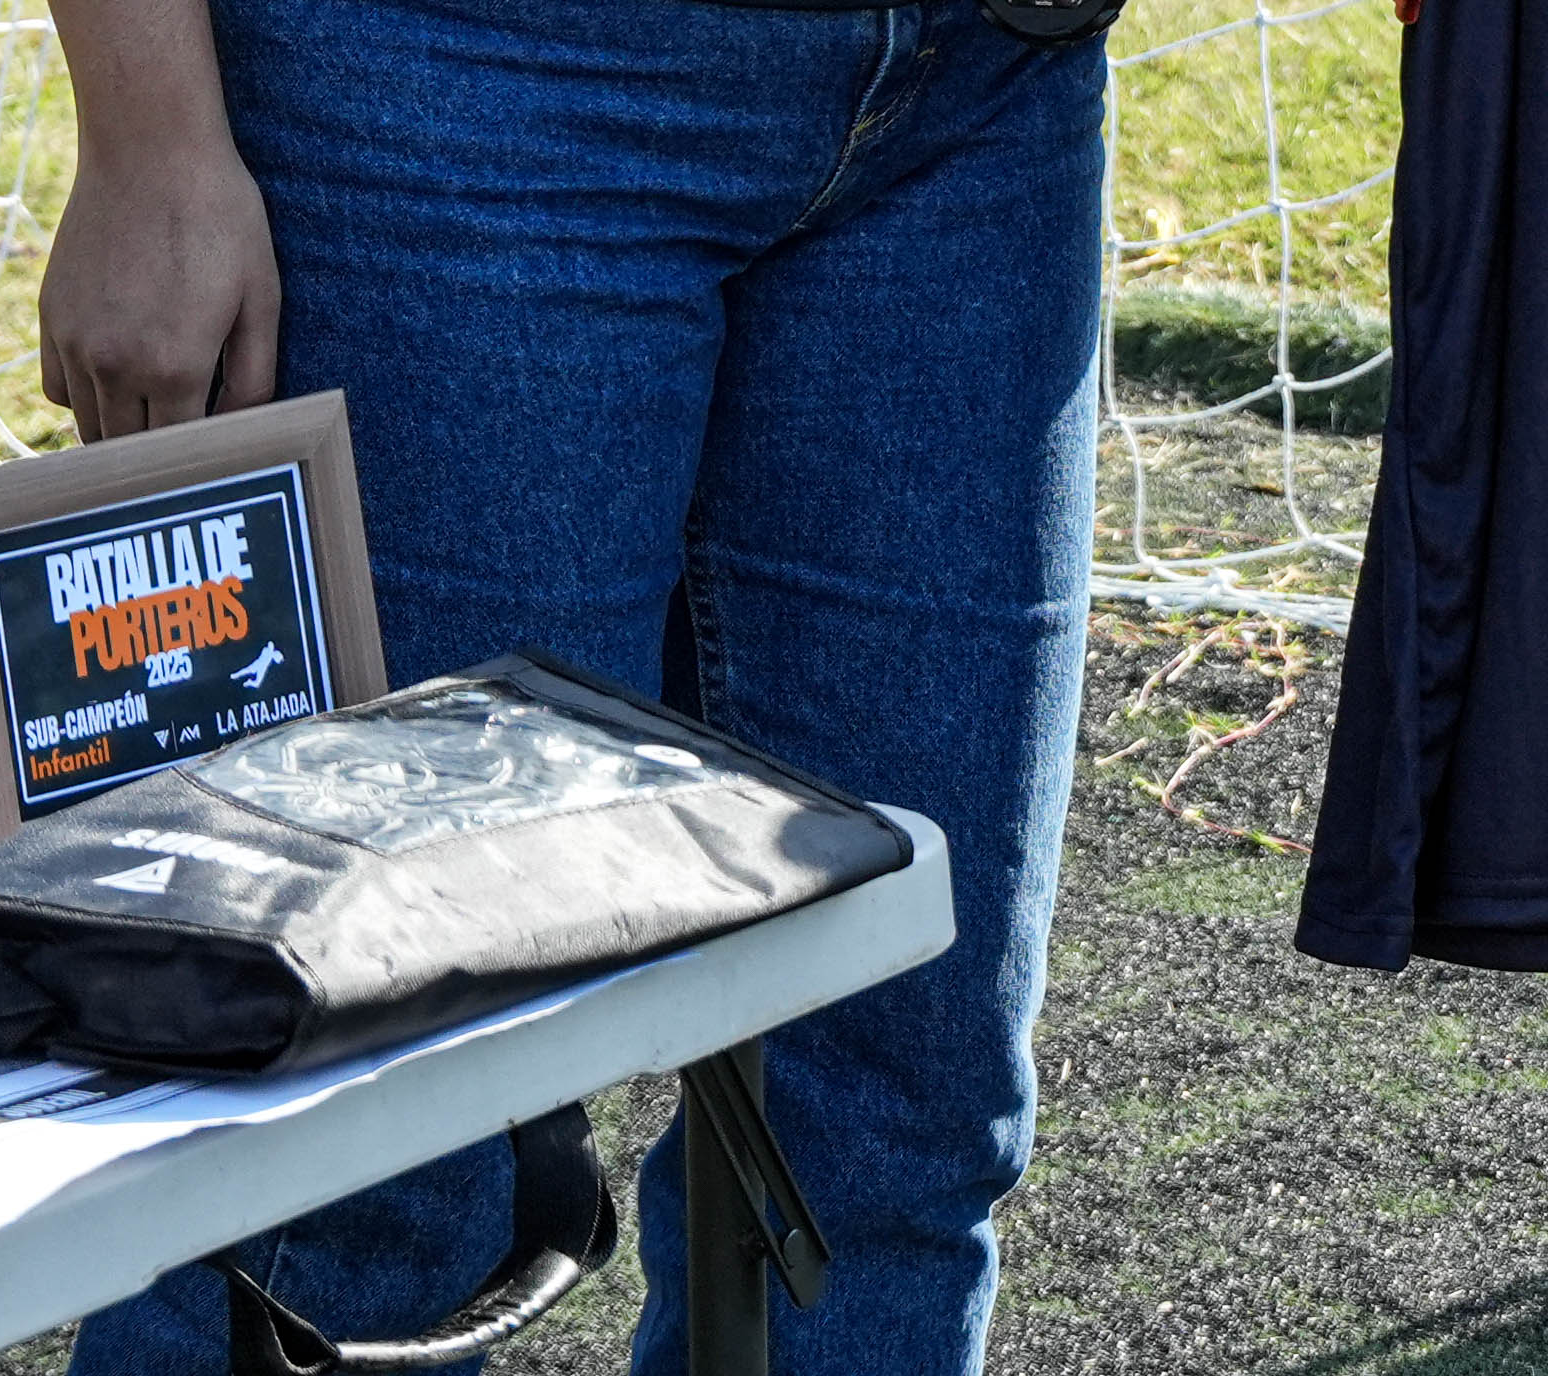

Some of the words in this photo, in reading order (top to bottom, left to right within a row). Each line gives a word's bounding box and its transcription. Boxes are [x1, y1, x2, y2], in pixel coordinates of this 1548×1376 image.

[45, 524, 204, 624] BATALLA
[200, 512, 252, 585] DE
[69, 576, 250, 678] PORTEROS
[145, 646, 193, 690] 2025
[24, 689, 149, 751] SUB-CAMPEÓN
[216, 709, 239, 735] LA
[243, 690, 311, 729] ATAJADA
[29, 738, 111, 782] Infantil
